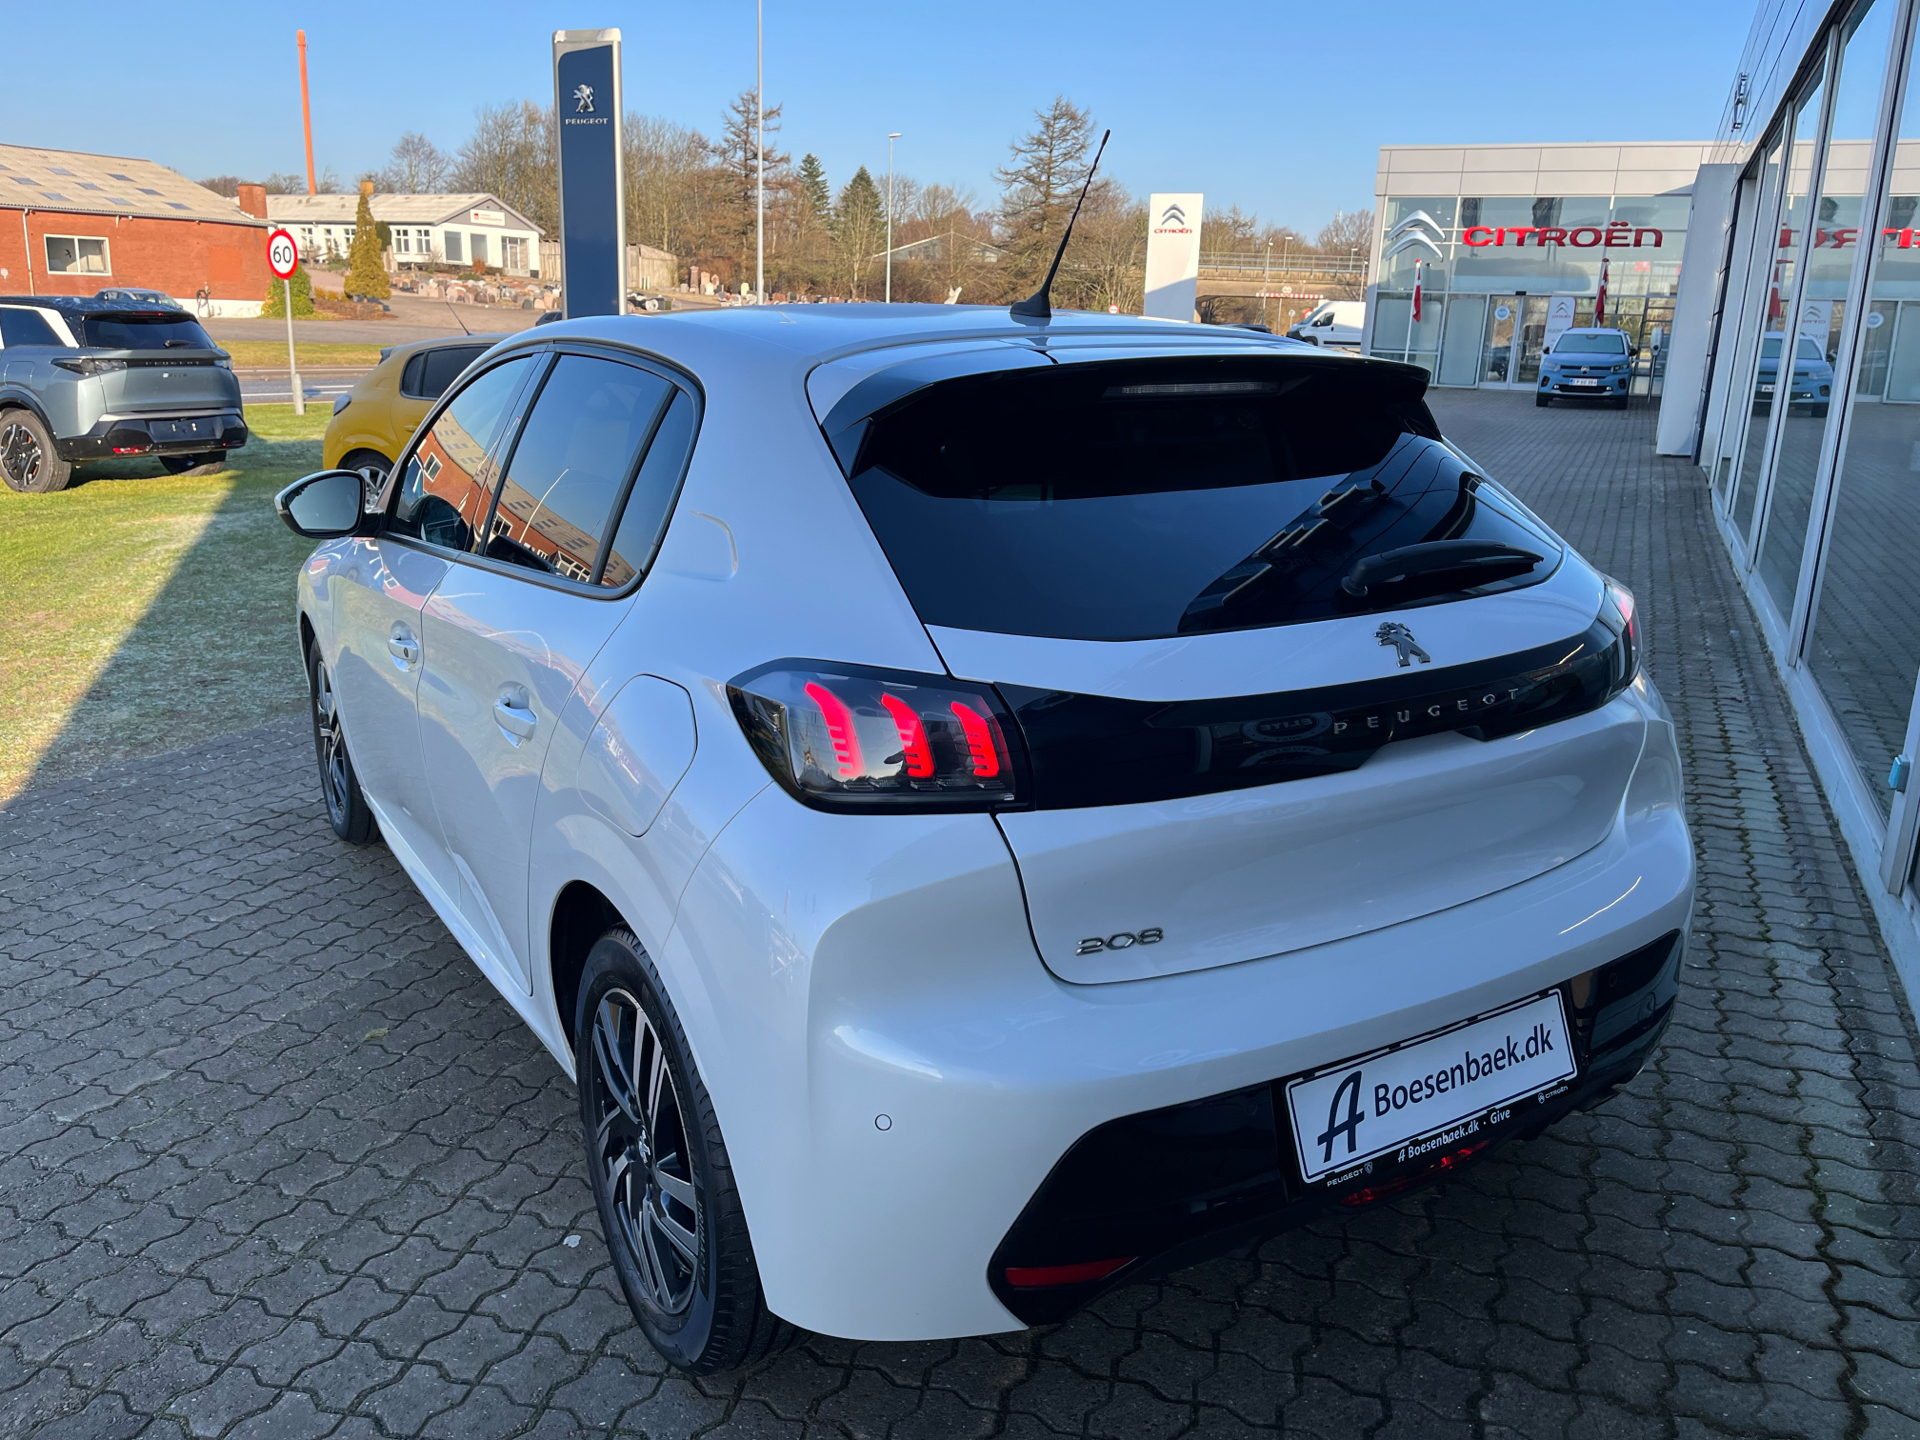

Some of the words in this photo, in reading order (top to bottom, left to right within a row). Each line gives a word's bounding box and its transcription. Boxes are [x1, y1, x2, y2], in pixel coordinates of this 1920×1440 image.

[565, 117, 608, 125] PEUGEOT
[1462, 221, 1664, 248] CITROËN
[273, 245, 292, 264] 60
[1333, 688, 1518, 735] PEUGEOT
[1075, 927, 1164, 956] 208
[1374, 1023, 1554, 1118] Boesenbaek.dk
[1545, 1085, 1569, 1099] CITROËN
[1408, 1118, 1480, 1159] Boesenbaek.dk
[1490, 1108, 1511, 1125] Give
[1326, 1168, 1364, 1188] PEUGEOT
